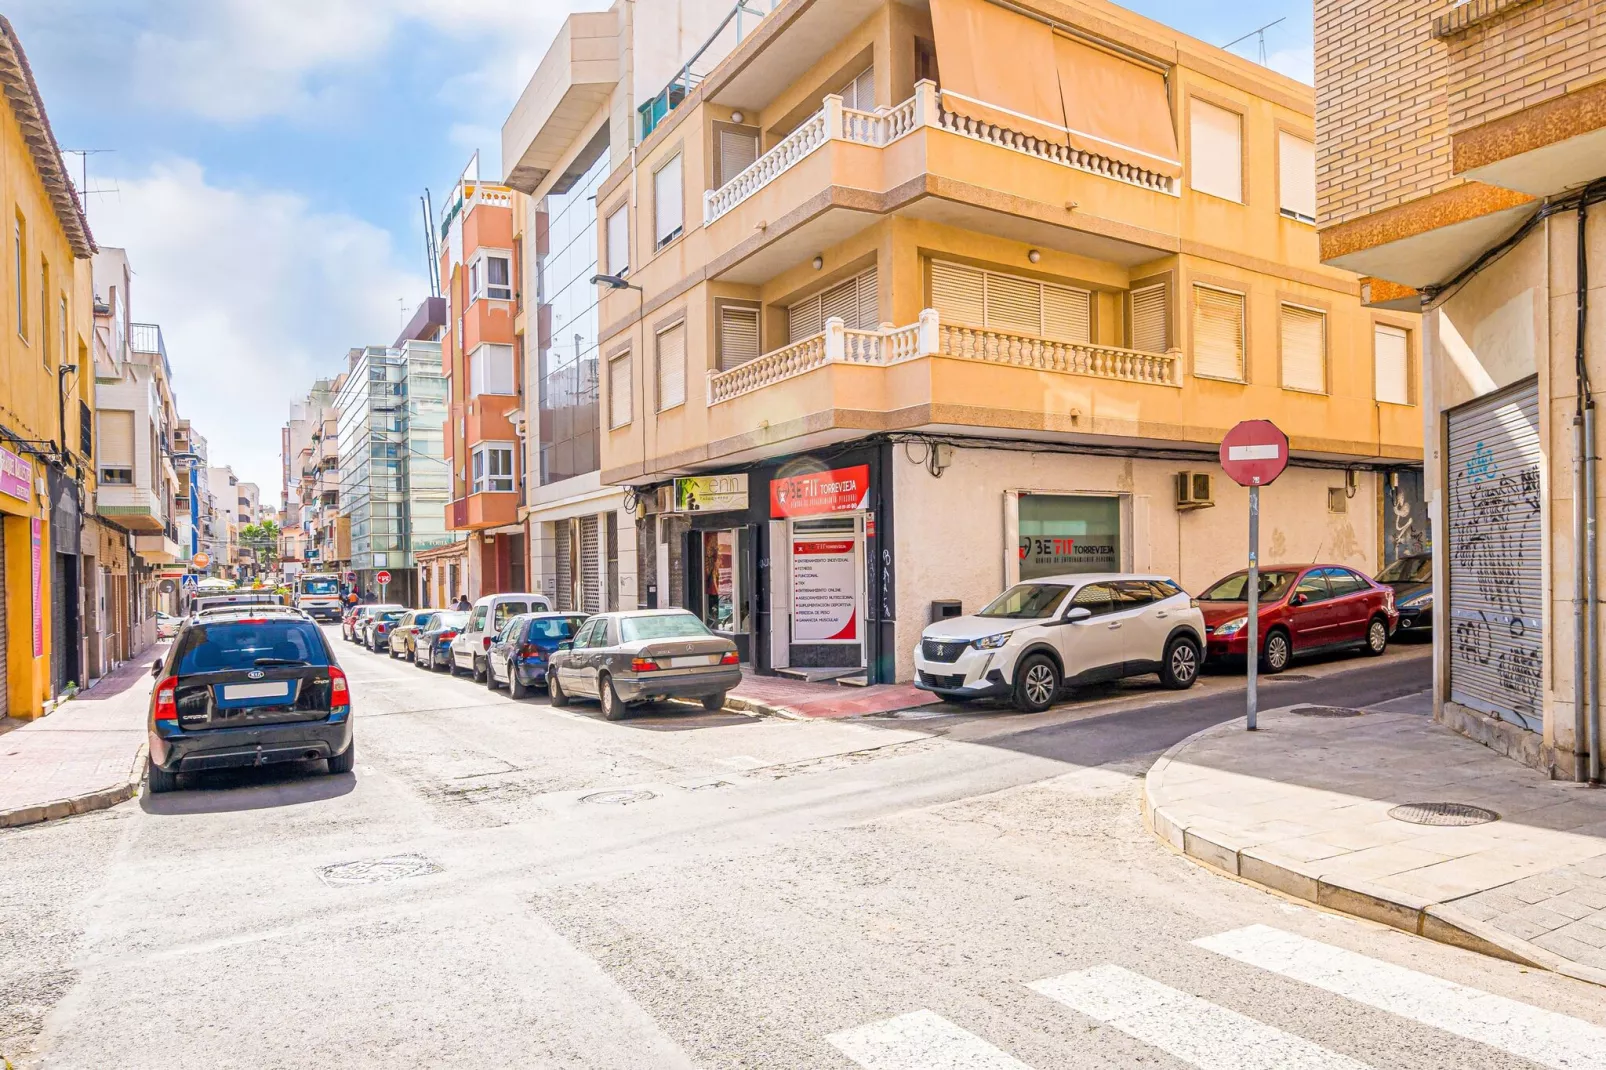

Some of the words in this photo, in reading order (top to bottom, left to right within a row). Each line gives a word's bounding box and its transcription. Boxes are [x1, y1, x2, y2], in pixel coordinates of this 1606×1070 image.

[820, 480, 856, 494] TORREVIEJA
[1053, 540, 1074, 555] FIT
[1074, 546, 1114, 554] TORREVIEJA
